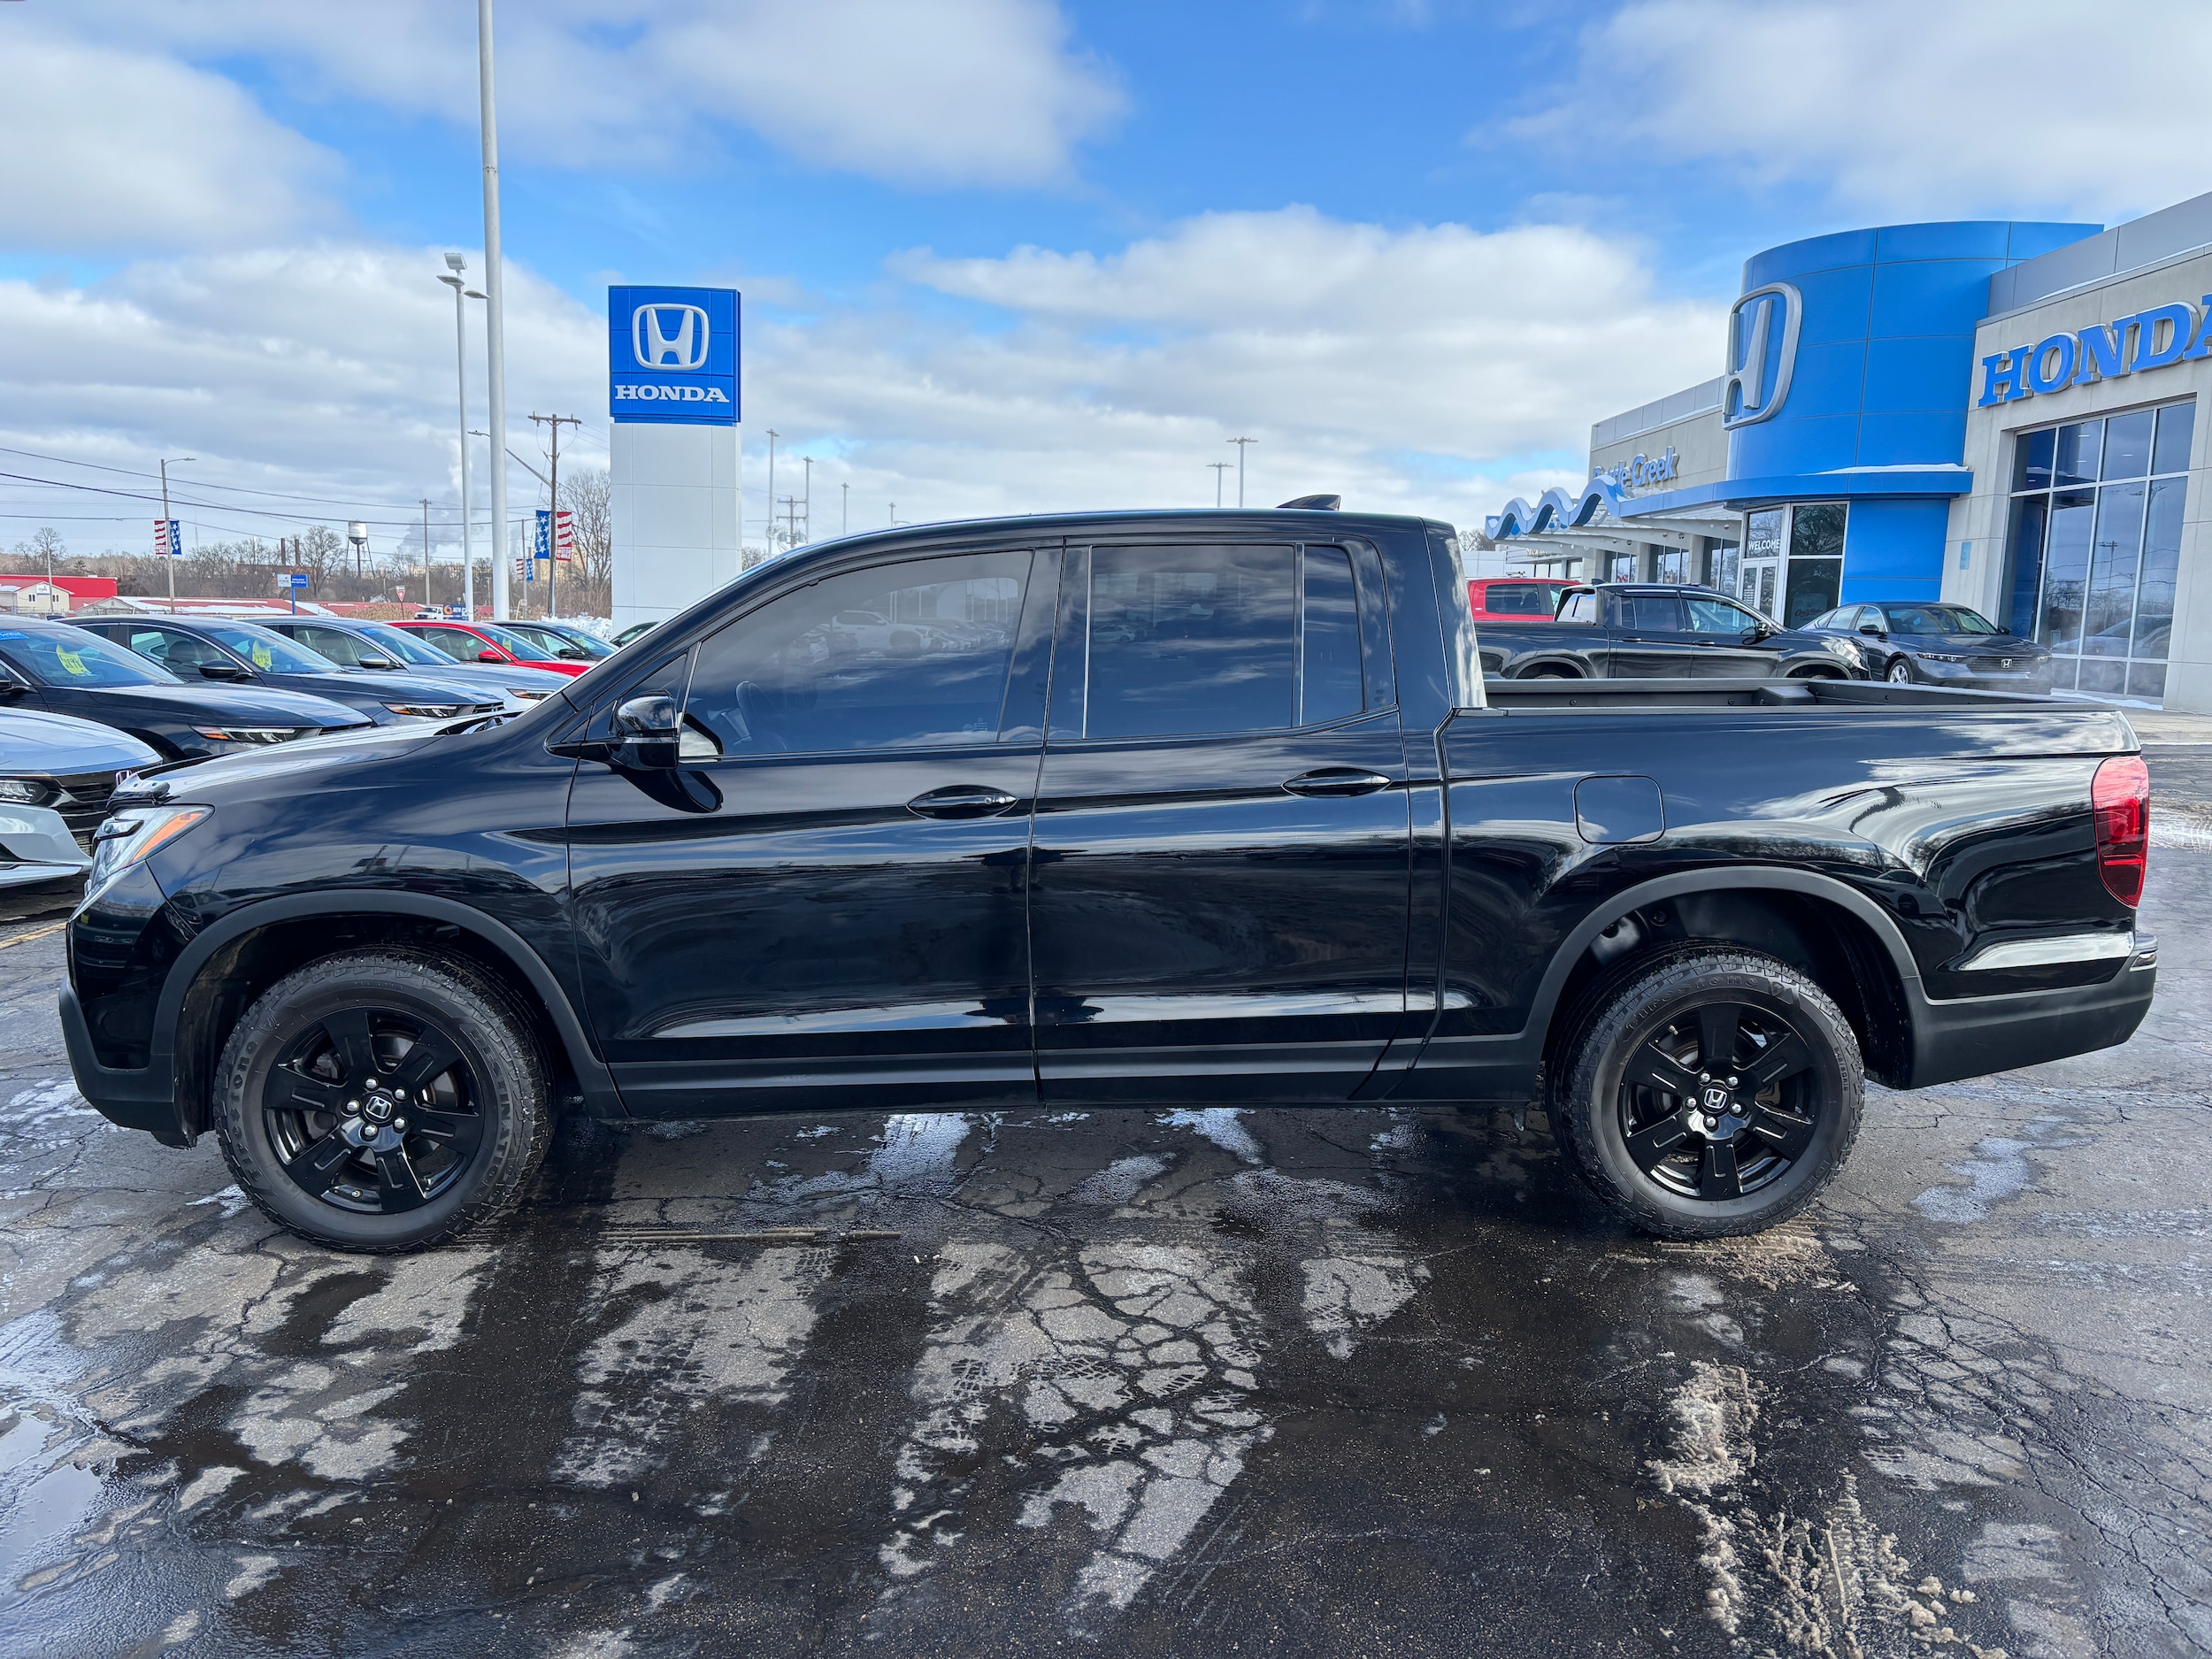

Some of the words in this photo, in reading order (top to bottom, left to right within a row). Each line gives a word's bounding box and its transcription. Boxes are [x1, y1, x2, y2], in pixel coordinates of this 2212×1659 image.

[615, 384, 730, 403] HONDA
[1632, 446, 1679, 487] Creek
[1747, 538, 1780, 550] WELCOME
